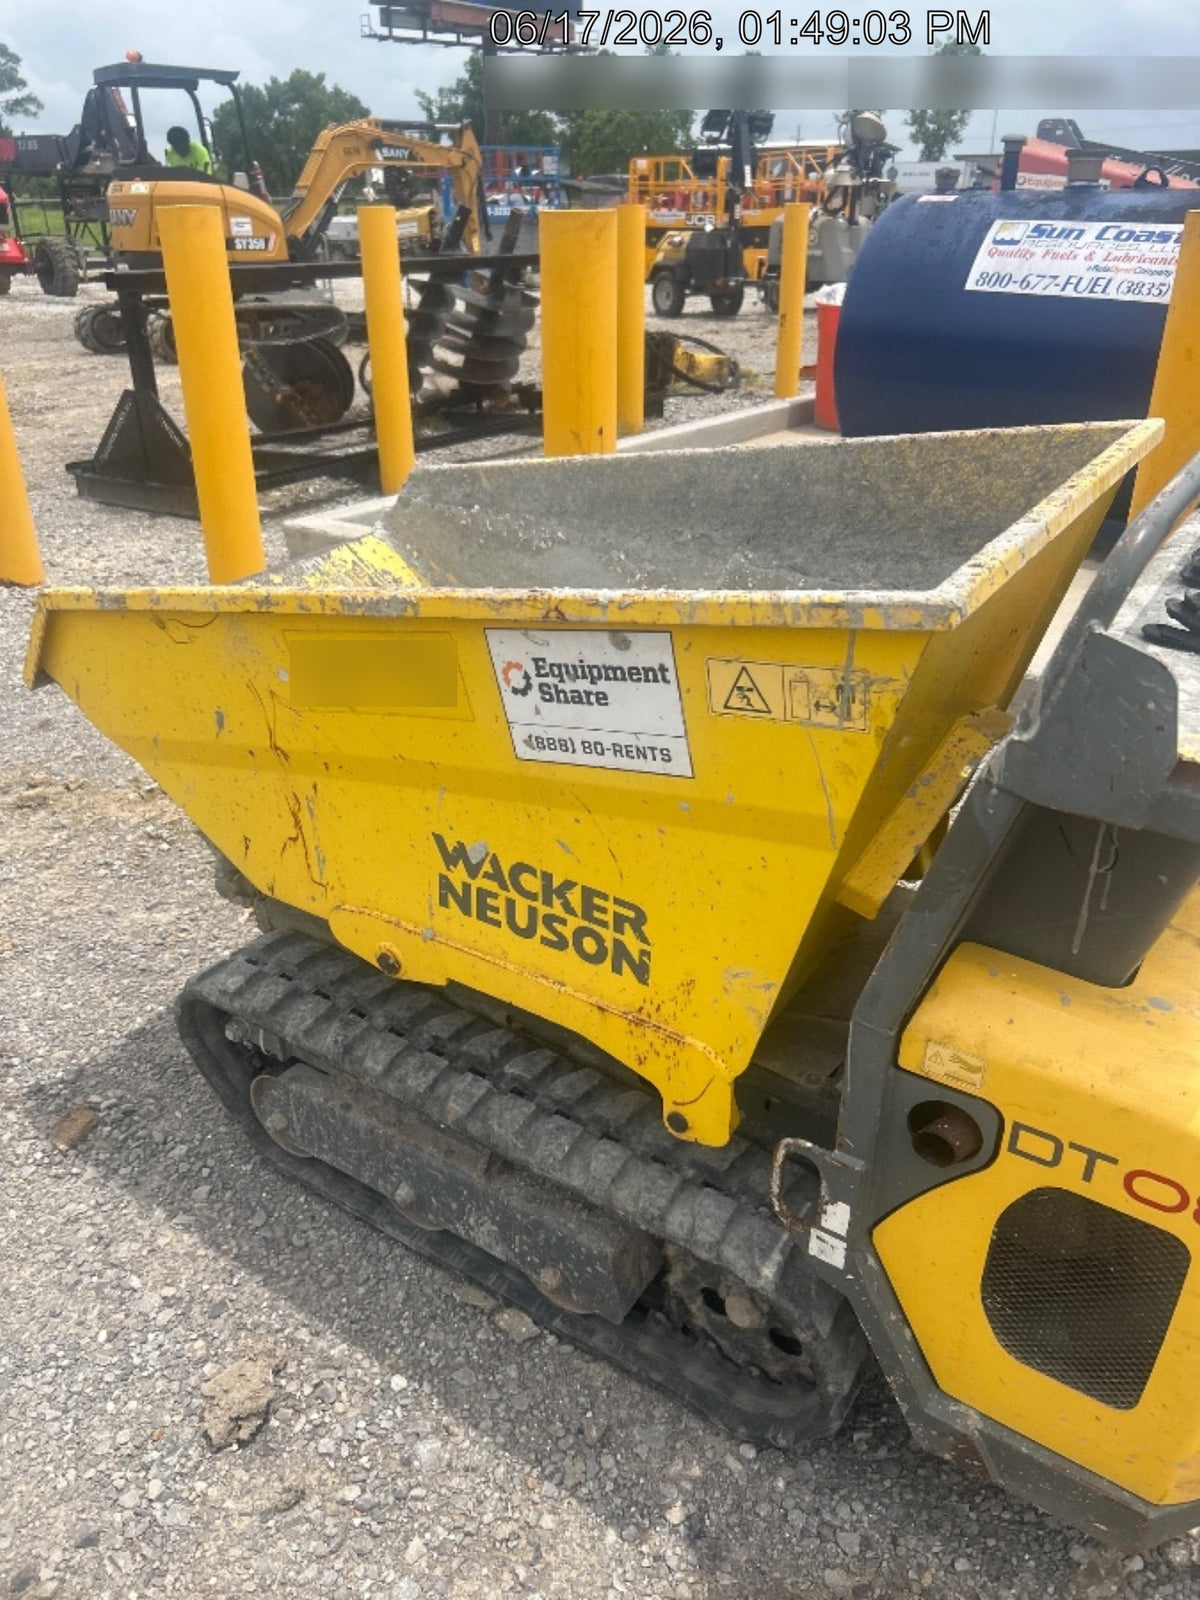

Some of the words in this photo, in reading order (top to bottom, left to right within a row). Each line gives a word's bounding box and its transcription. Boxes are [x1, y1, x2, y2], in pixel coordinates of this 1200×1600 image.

[685, 213, 716, 226] JCB
[1026, 224, 1086, 242] Sun
[987, 246, 1035, 261] Quality
[1042, 247, 1078, 261] Fuels
[1084, 250, 1095, 262] &
[975, 271, 1111, 295] 800-677-FUEL
[1116, 279, 1172, 298] (3835)
[531, 657, 671, 685] Equipment
[538, 682, 609, 707] Share
[528, 733, 576, 755] (888)
[432, 831, 651, 946] WACKER
[439, 872, 651, 987] NEUSON
[1007, 1120, 1200, 1226] DT0
